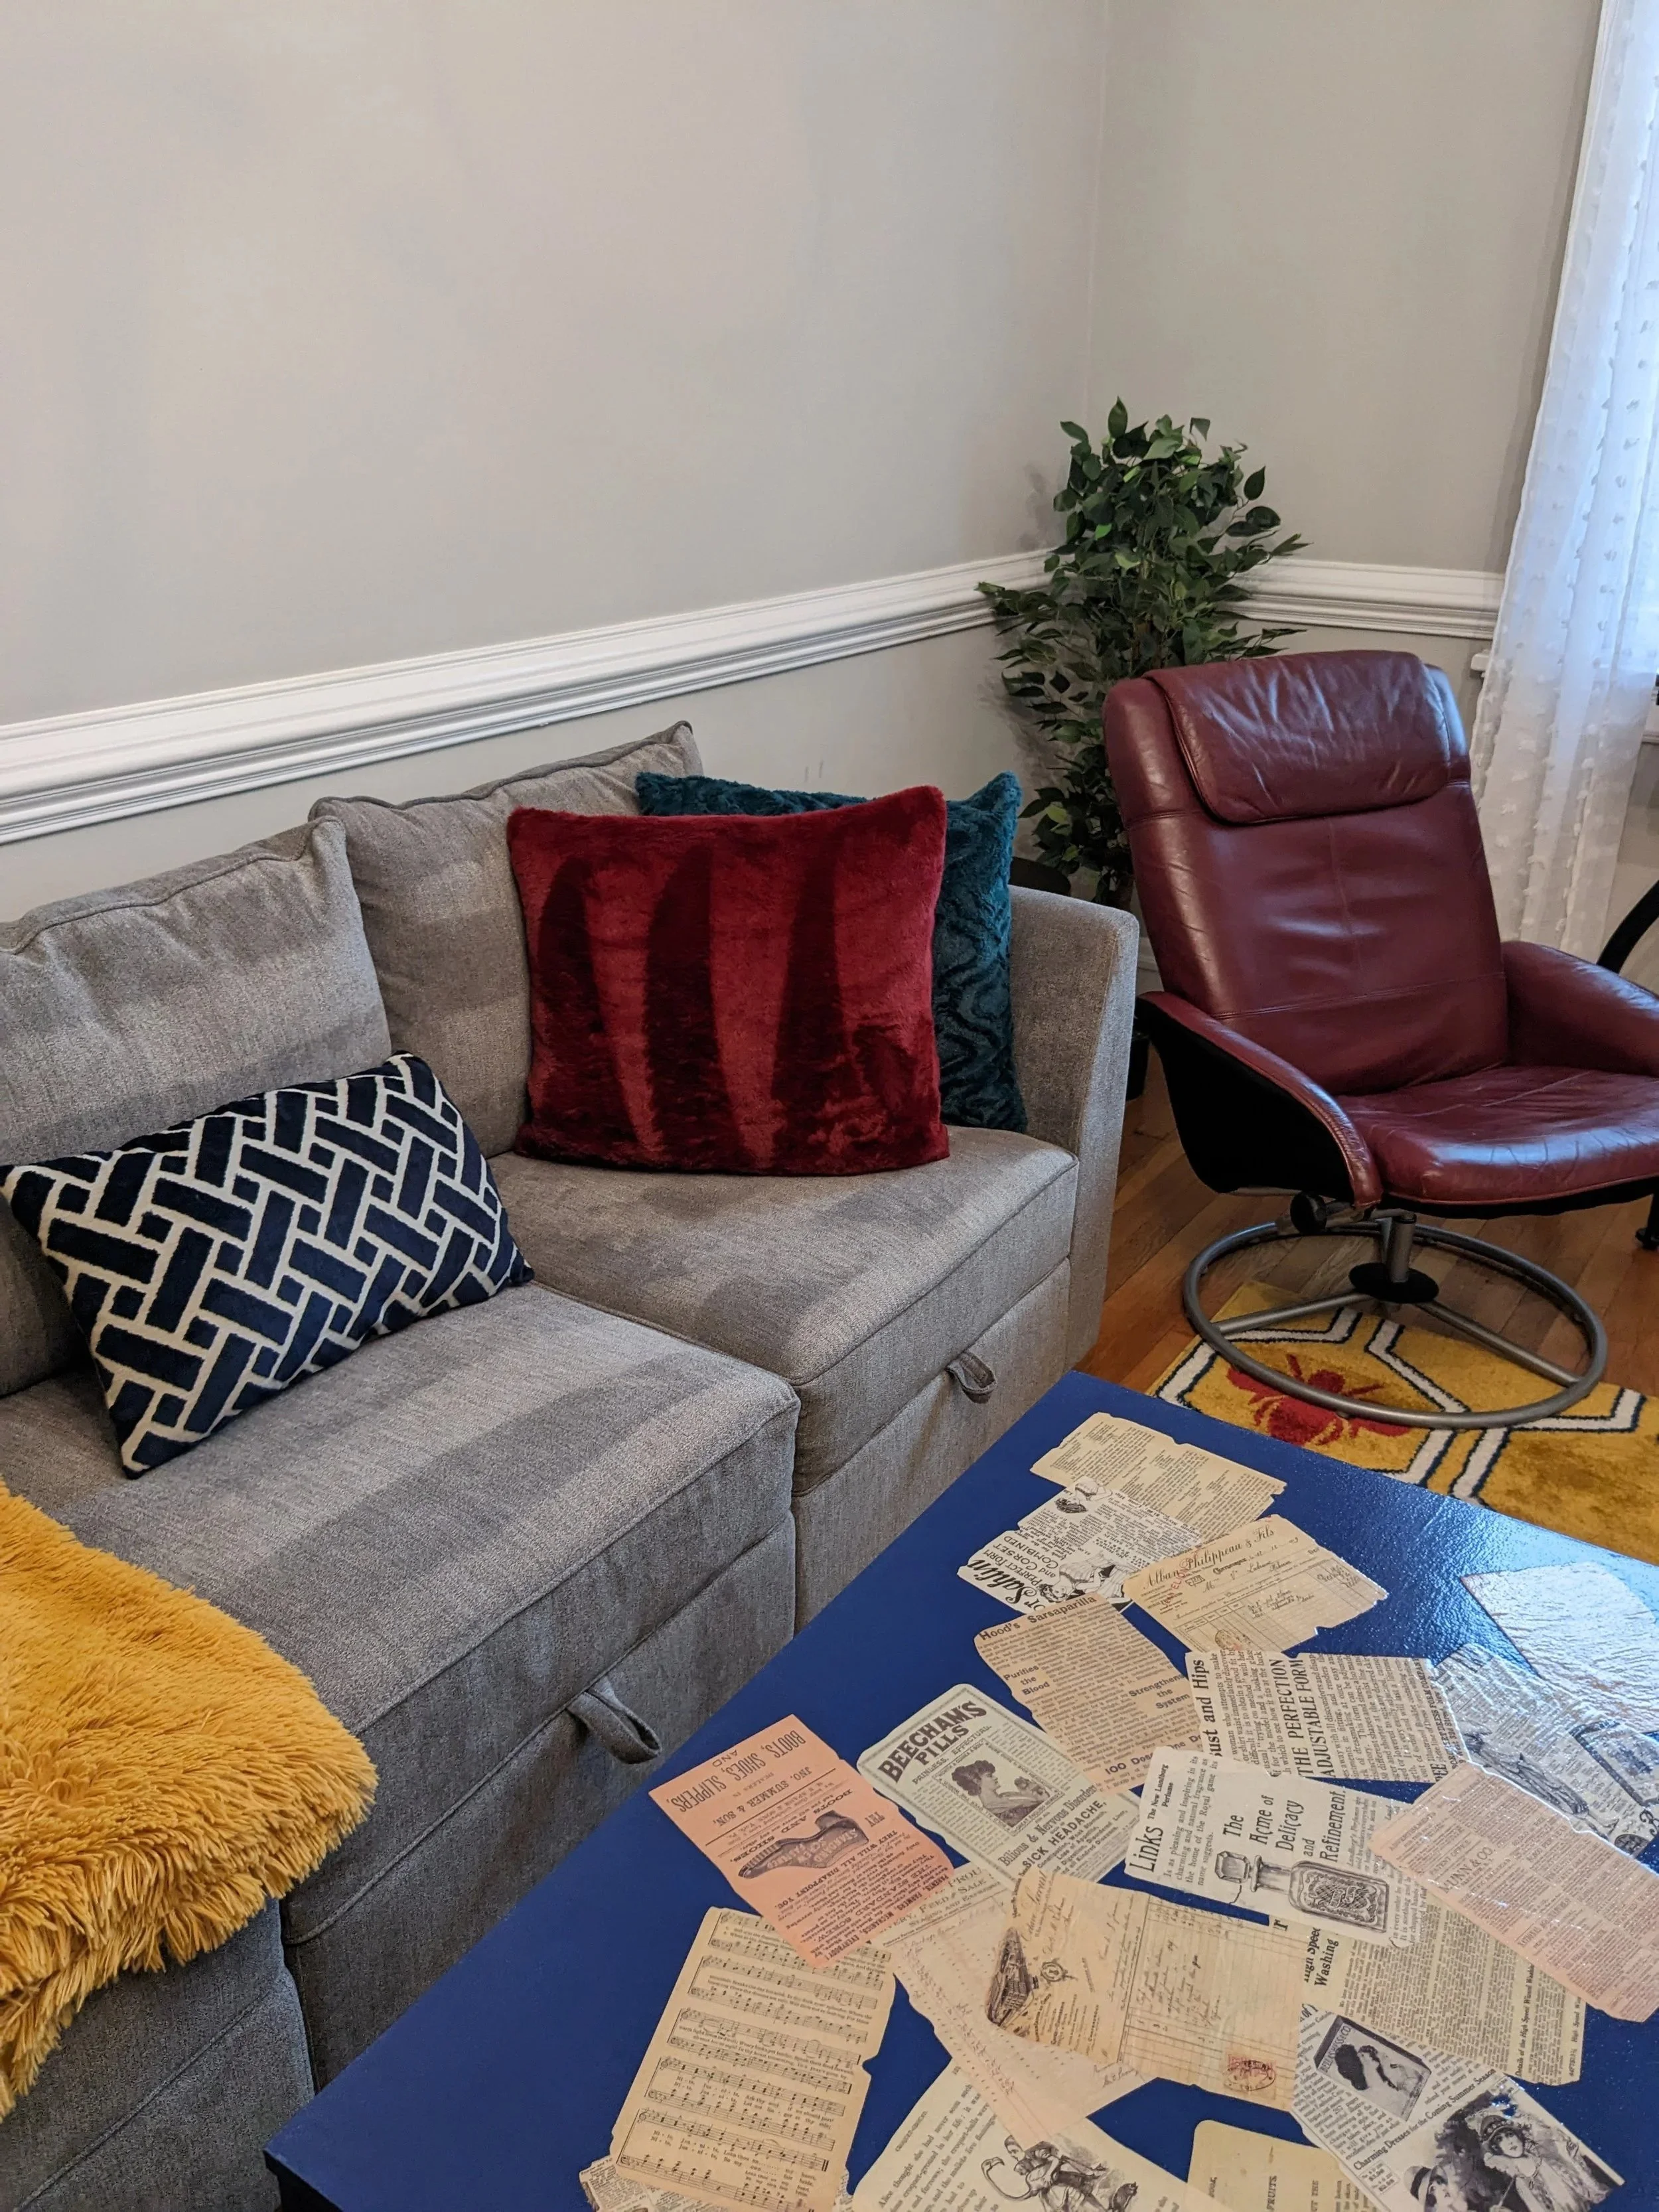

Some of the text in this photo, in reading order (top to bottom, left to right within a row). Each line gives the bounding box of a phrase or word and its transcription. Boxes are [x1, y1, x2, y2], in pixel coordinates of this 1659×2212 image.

[993, 1543, 1055, 1578] and CORSET
[1004, 1536, 1058, 1568] COMBINED
[1143, 1570, 1184, 1589] Alban
[1181, 1544, 1242, 1577] Philippeau
[1254, 1525, 1274, 1542] Fils
[983, 1549, 1043, 1585] PERFECT FORM
[968, 1560, 1037, 1604] Sahlin
[977, 1597, 1097, 1641] Hood's Sarsaparilla
[1003, 1665, 1039, 1684] Purifies
[1191, 1660, 1209, 1689] Hips
[1210, 1653, 1220, 1670] make
[1020, 1676, 1037, 1685] the
[1021, 1681, 1050, 1695] Blood
[1128, 1672, 1187, 1696] Strengthens
[1217, 1680, 1229, 1710] attempts
[1155, 1694, 1190, 1708] System
[1195, 1696, 1216, 1723] and
[1225, 1675, 1240, 1716] immediately
[1222, 1713, 1232, 1727] who
[1233, 1718, 1243, 1735] waist
[1273, 1660, 1314, 1776] THE PERFECTION
[1295, 1660, 1334, 1777] ADJUSTABLE FORM
[878, 1700, 987, 1783] BEECHAM'S
[914, 1724, 969, 1765] PILLS
[1228, 1730, 1238, 1755] woman
[1237, 1736, 1248, 1752] shirt
[666, 1730, 806, 1812] BOOTS, SHOES, SLIPPERS,
[712, 1749, 737, 1767] AND
[912, 1757, 949, 1785] PAINLESS.
[1105, 1763, 1127, 1775] 100
[743, 1772, 774, 1791] DEALERS
[790, 1767, 812, 1781] JNO.
[747, 1780, 789, 1807] SUMMER
[1161, 1783, 1173, 1807] Perfume
[713, 1810, 737, 1826] SON,
[730, 1789, 852, 1862] BOOTS AND SHOES,
[865, 1811, 885, 1827] TRY
[1129, 1764, 1169, 1872] Links The New Lundborg
[1169, 1826, 1185, 1856] pleasing
[1179, 1777, 1195, 1807] inspiring
[1175, 1846, 1191, 1880] charming
[1184, 1829, 1192, 1843] and
[1188, 1801, 1198, 1826] natural
[1193, 1768, 1206, 1800] fragrance
[1185, 1761, 1218, 1883] the home of the Royal game its
[1222, 1815, 1244, 1837] The
[1249, 1795, 1274, 1845] Acme of
[1275, 1800, 1304, 1852] Delicacy
[1319, 1791, 1346, 1862] Refinement.
[810, 1826, 859, 1864] STANDARD
[997, 1842, 1029, 1866] Bilious
[1026, 1834, 1039, 1842] &
[1034, 1804, 1069, 1836] Nervous
[1022, 1846, 1048, 1871] SICK
[1048, 1801, 1107, 1846] HEADACHE,
[1302, 1837, 1315, 1857] and
[794, 1836, 827, 1864] SCREW
[1197, 1832, 1213, 1885] name suggests.
[1469, 1859, 1481, 1868] &
[1477, 1847, 1496, 1860] CO.
[774, 1830, 897, 1909] THEY WILL ALL DISAPPOINT YOU.
[910, 1864, 932, 1879] THE
[851, 1878, 908, 1915] STANDARD
[958, 1879, 986, 1893] SALE
[810, 1915, 851, 1942] SCREW.
[1314, 1938, 1339, 1986] Washing
[1521, 2006, 1530, 2023] Speed
[1520, 2024, 1528, 2037] High
[1514, 2057, 1524, 2077] Details
[1353, 2146, 1388, 2170] Charming
[1384, 2130, 1411, 2148] Dresses
[1425, 2097, 1452, 2119] Coming
[1448, 2083, 1476, 2102] Summer
[1473, 2069, 1496, 2085] Season
[879, 2191, 893, 2208] Alice
[893, 2164, 913, 2188] thought
[922, 2134, 934, 2148] had
[934, 2116, 948, 2133] never
[902, 2150, 938, 2198] croquet-ground
